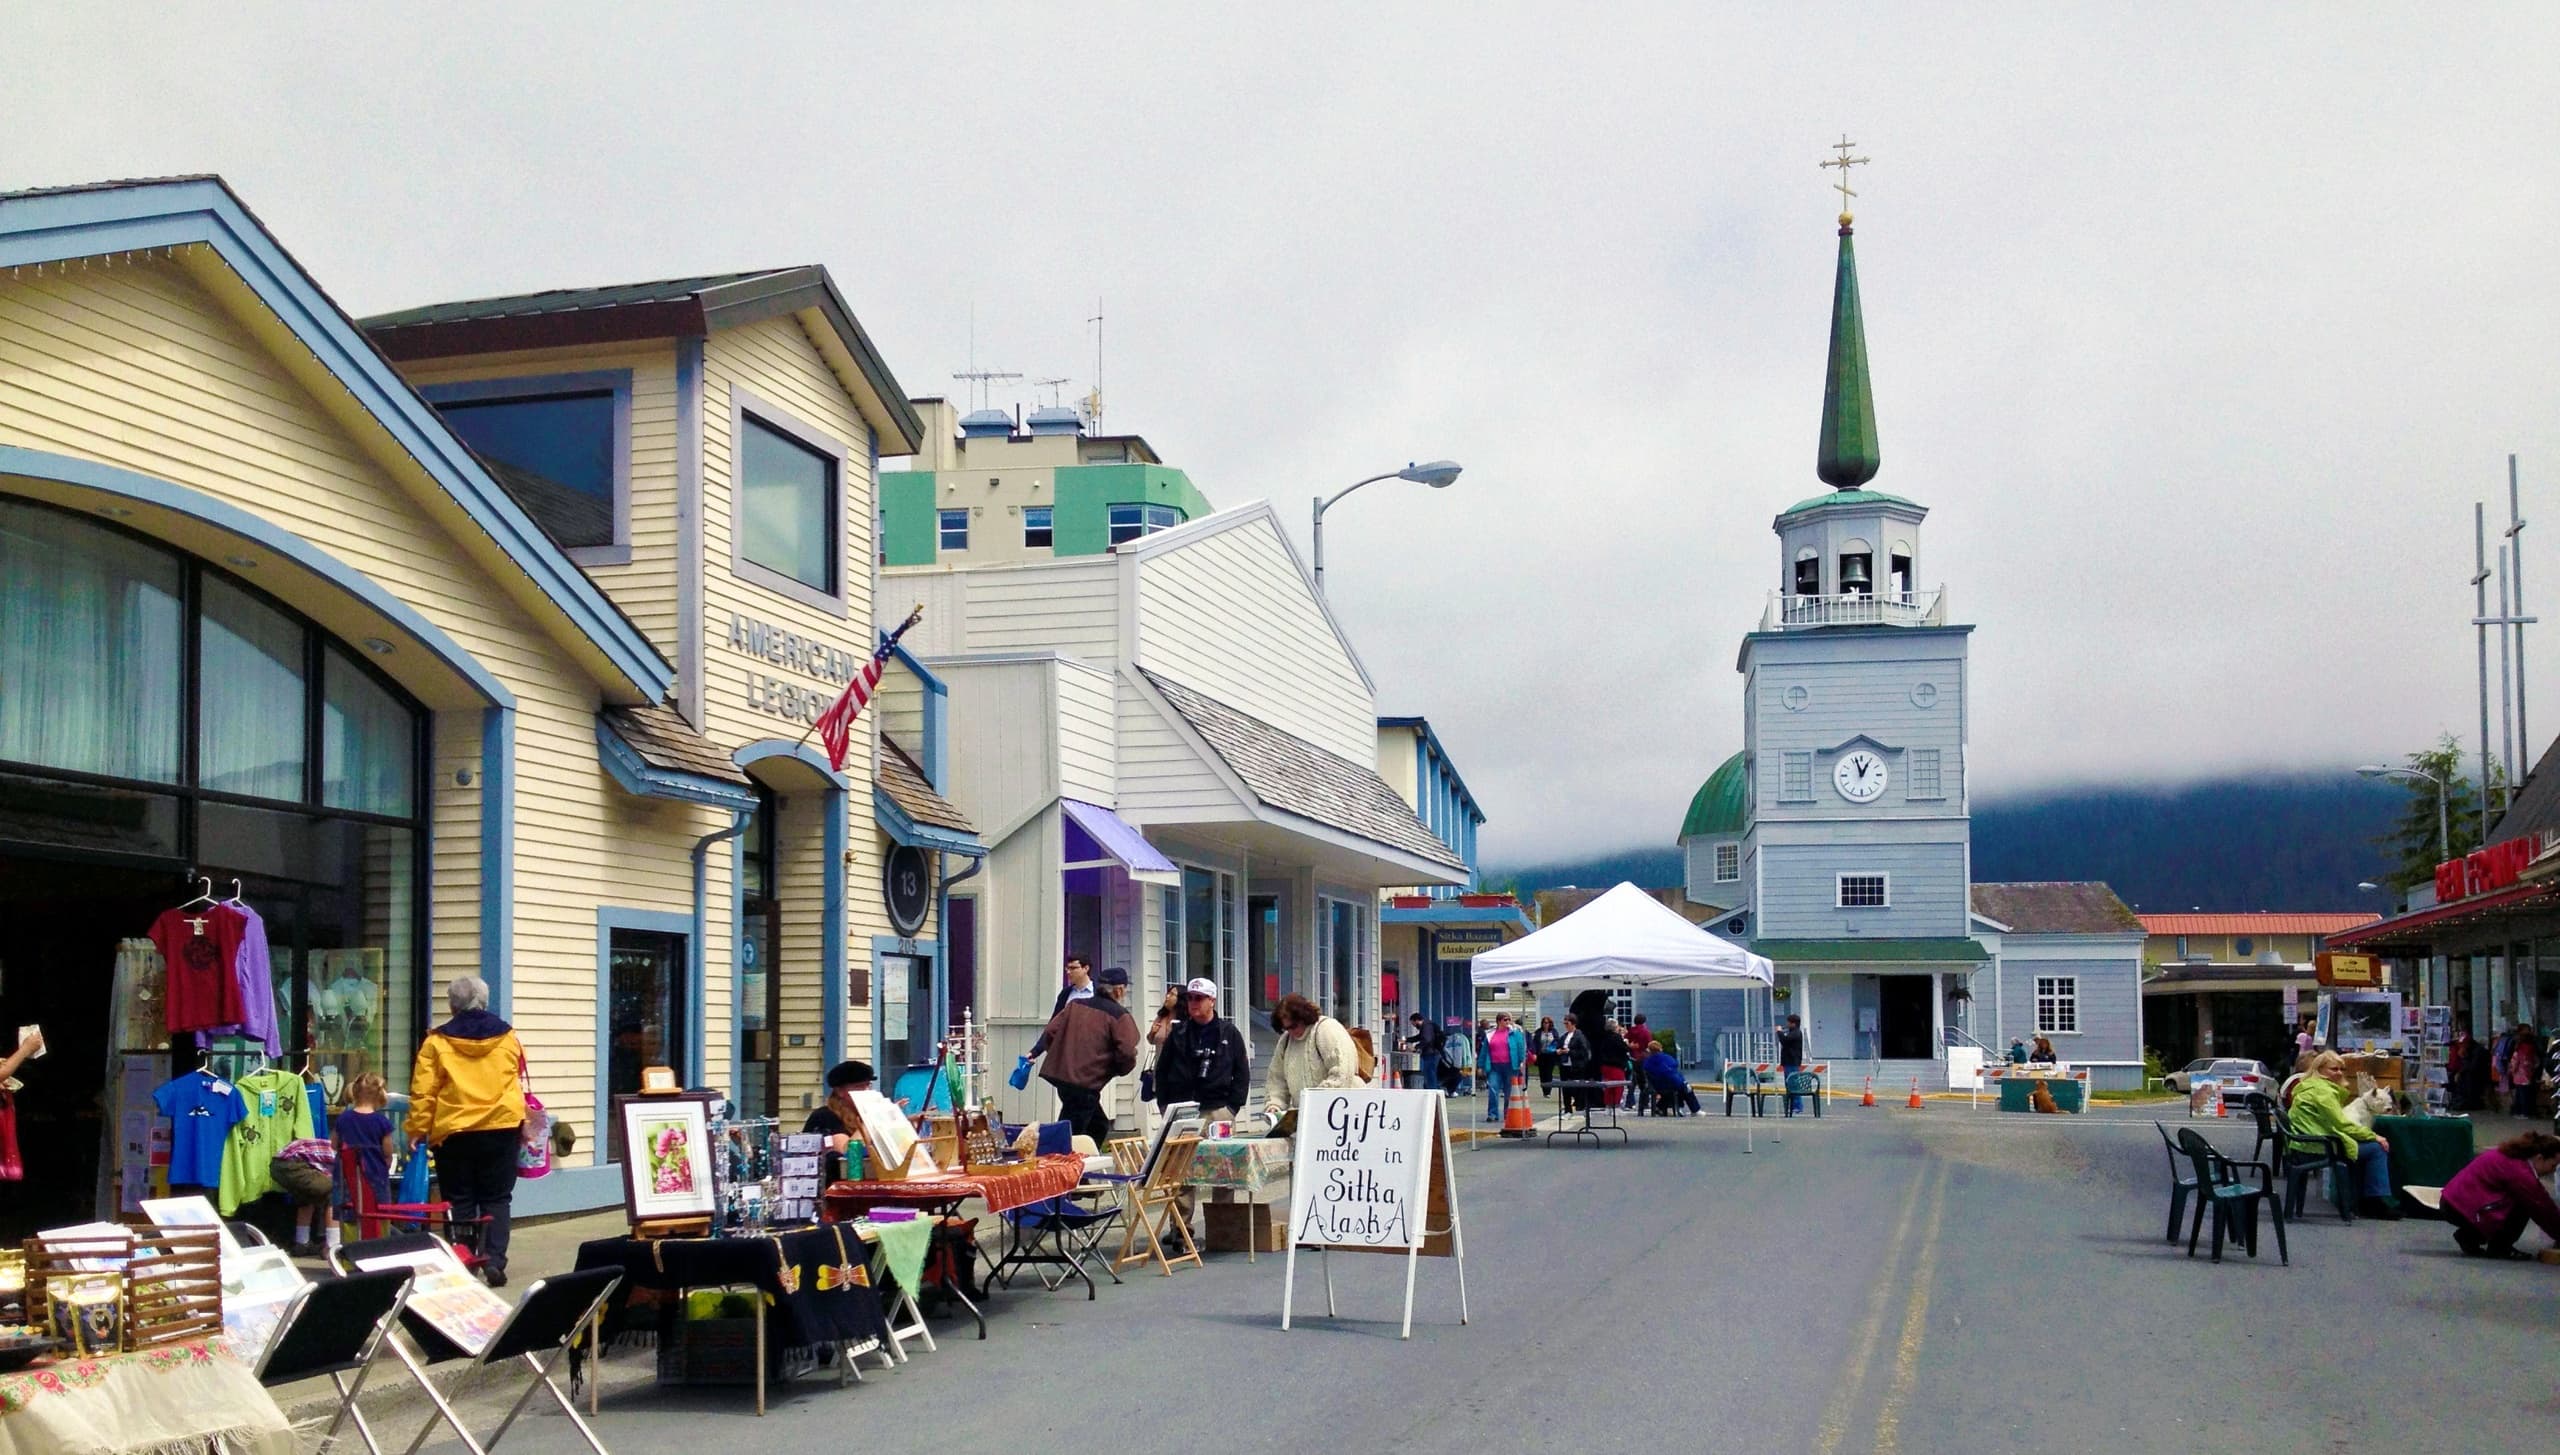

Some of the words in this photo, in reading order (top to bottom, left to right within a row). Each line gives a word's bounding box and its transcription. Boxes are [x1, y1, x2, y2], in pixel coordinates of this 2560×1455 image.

[727, 612, 855, 685] AMERICAN
[901, 871, 918, 897] 13
[898, 938, 918, 954] 205
[1442, 945, 1475, 954] Alaskan
[1327, 1096, 1401, 1147] Gifts
[1316, 1142, 1360, 1162] made
[1384, 1147, 1403, 1164] in
[1324, 1167, 1396, 1204] Sitka
